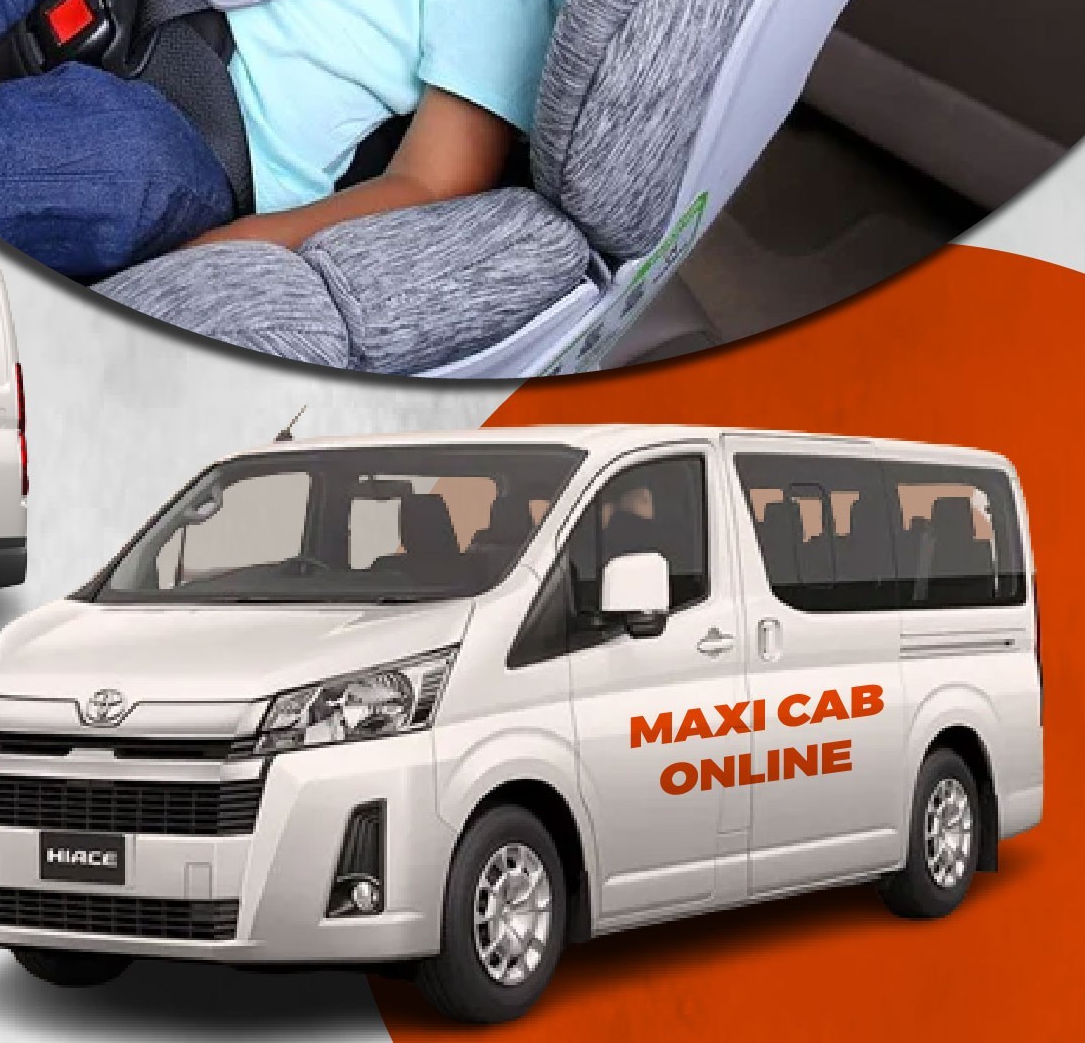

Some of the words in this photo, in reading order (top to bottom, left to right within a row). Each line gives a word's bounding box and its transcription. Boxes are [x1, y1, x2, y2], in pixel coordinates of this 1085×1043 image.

[630, 698, 766, 749] MAXI
[777, 684, 885, 727] CAB
[659, 739, 853, 796] ONLINE
[46, 847, 118, 868] HIACE
